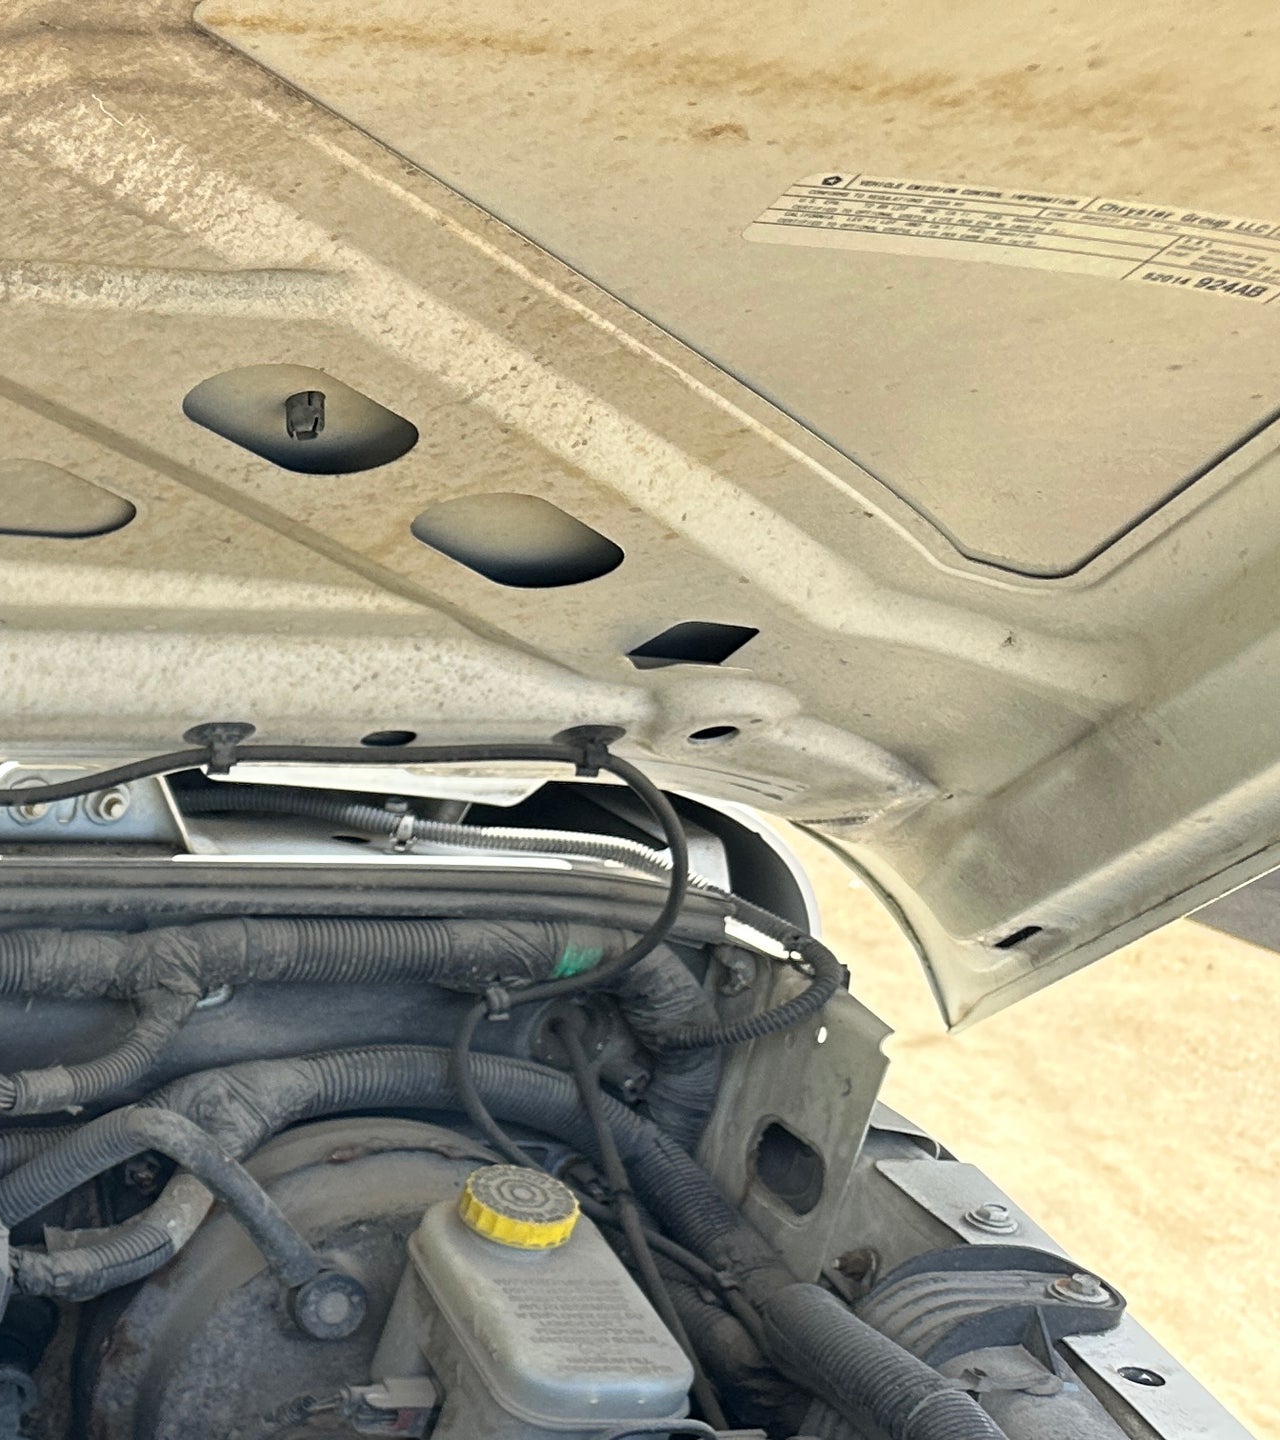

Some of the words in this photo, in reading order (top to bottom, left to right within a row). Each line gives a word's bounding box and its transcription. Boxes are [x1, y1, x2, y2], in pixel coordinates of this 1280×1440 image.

[1099, 203, 1174, 218] Chrysler
[1181, 214, 1231, 227] Group
[1236, 222, 1270, 233] LLC
[1194, 277, 1268, 297] 924AB
